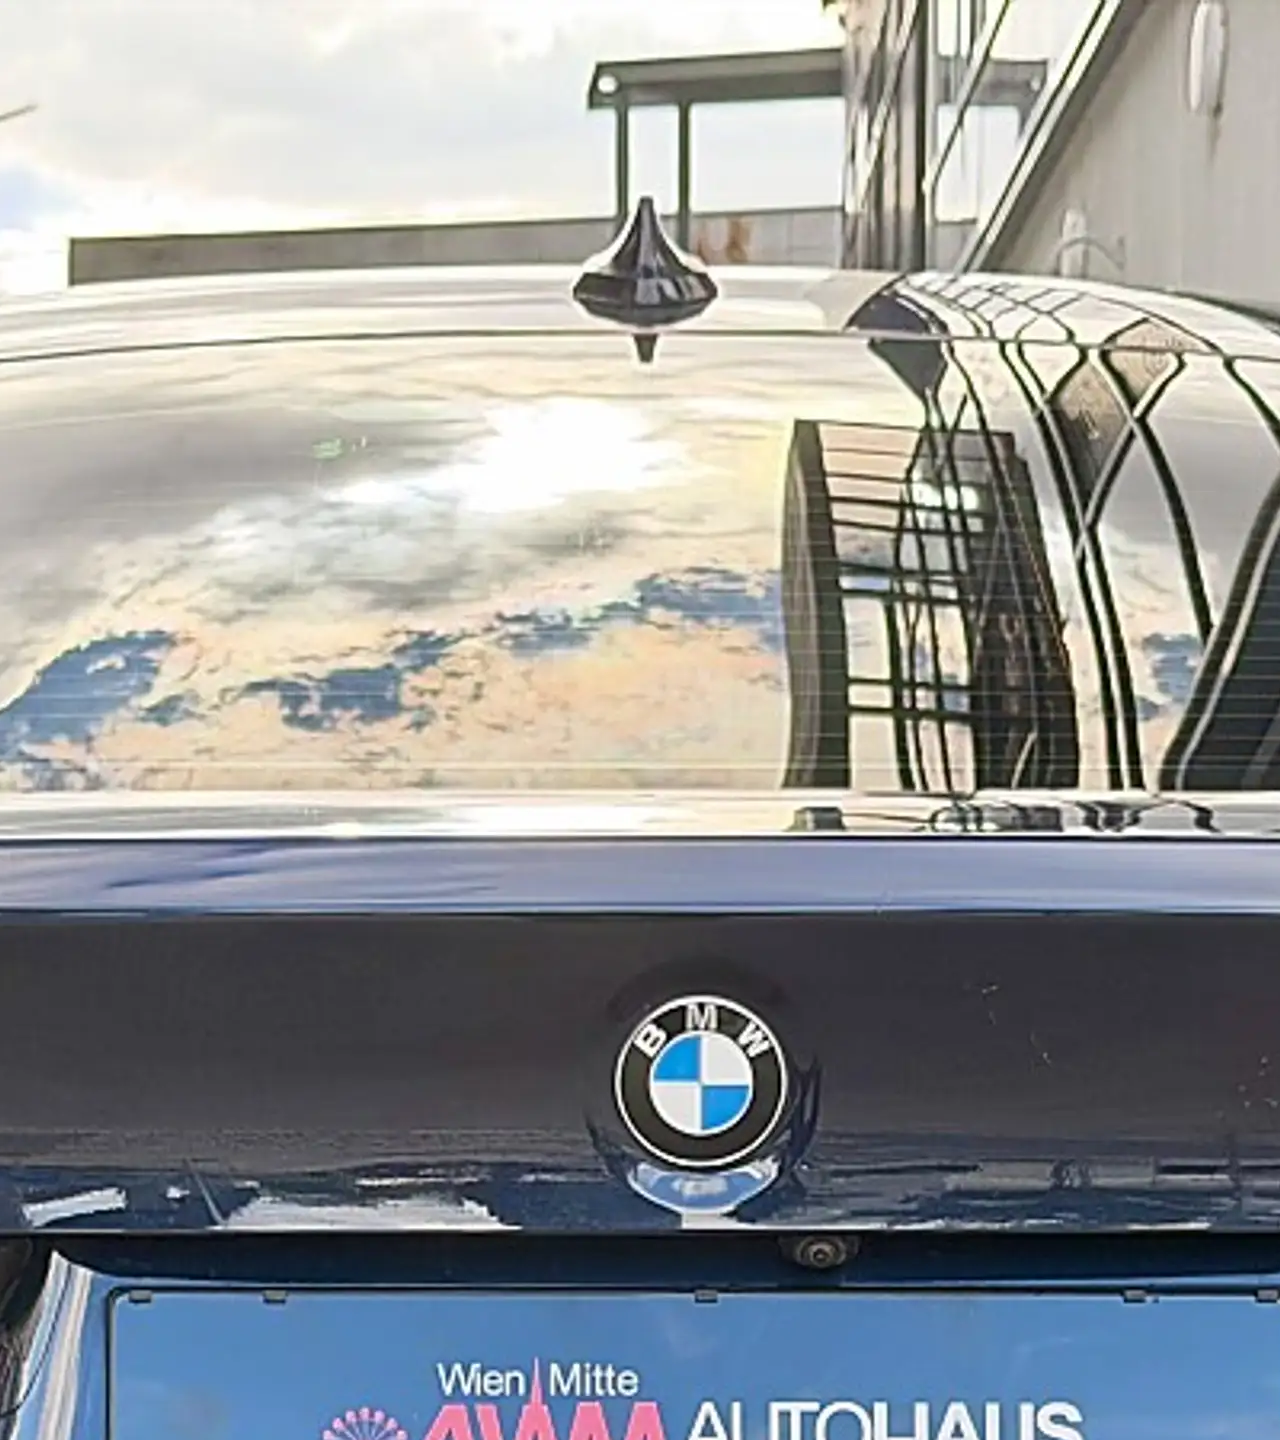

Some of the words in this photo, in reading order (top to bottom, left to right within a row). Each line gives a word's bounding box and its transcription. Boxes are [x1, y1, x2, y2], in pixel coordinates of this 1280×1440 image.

[633, 1003, 770, 1058] BMW
[436, 1361, 525, 1396] Wien
[549, 1361, 639, 1397] Mitte
